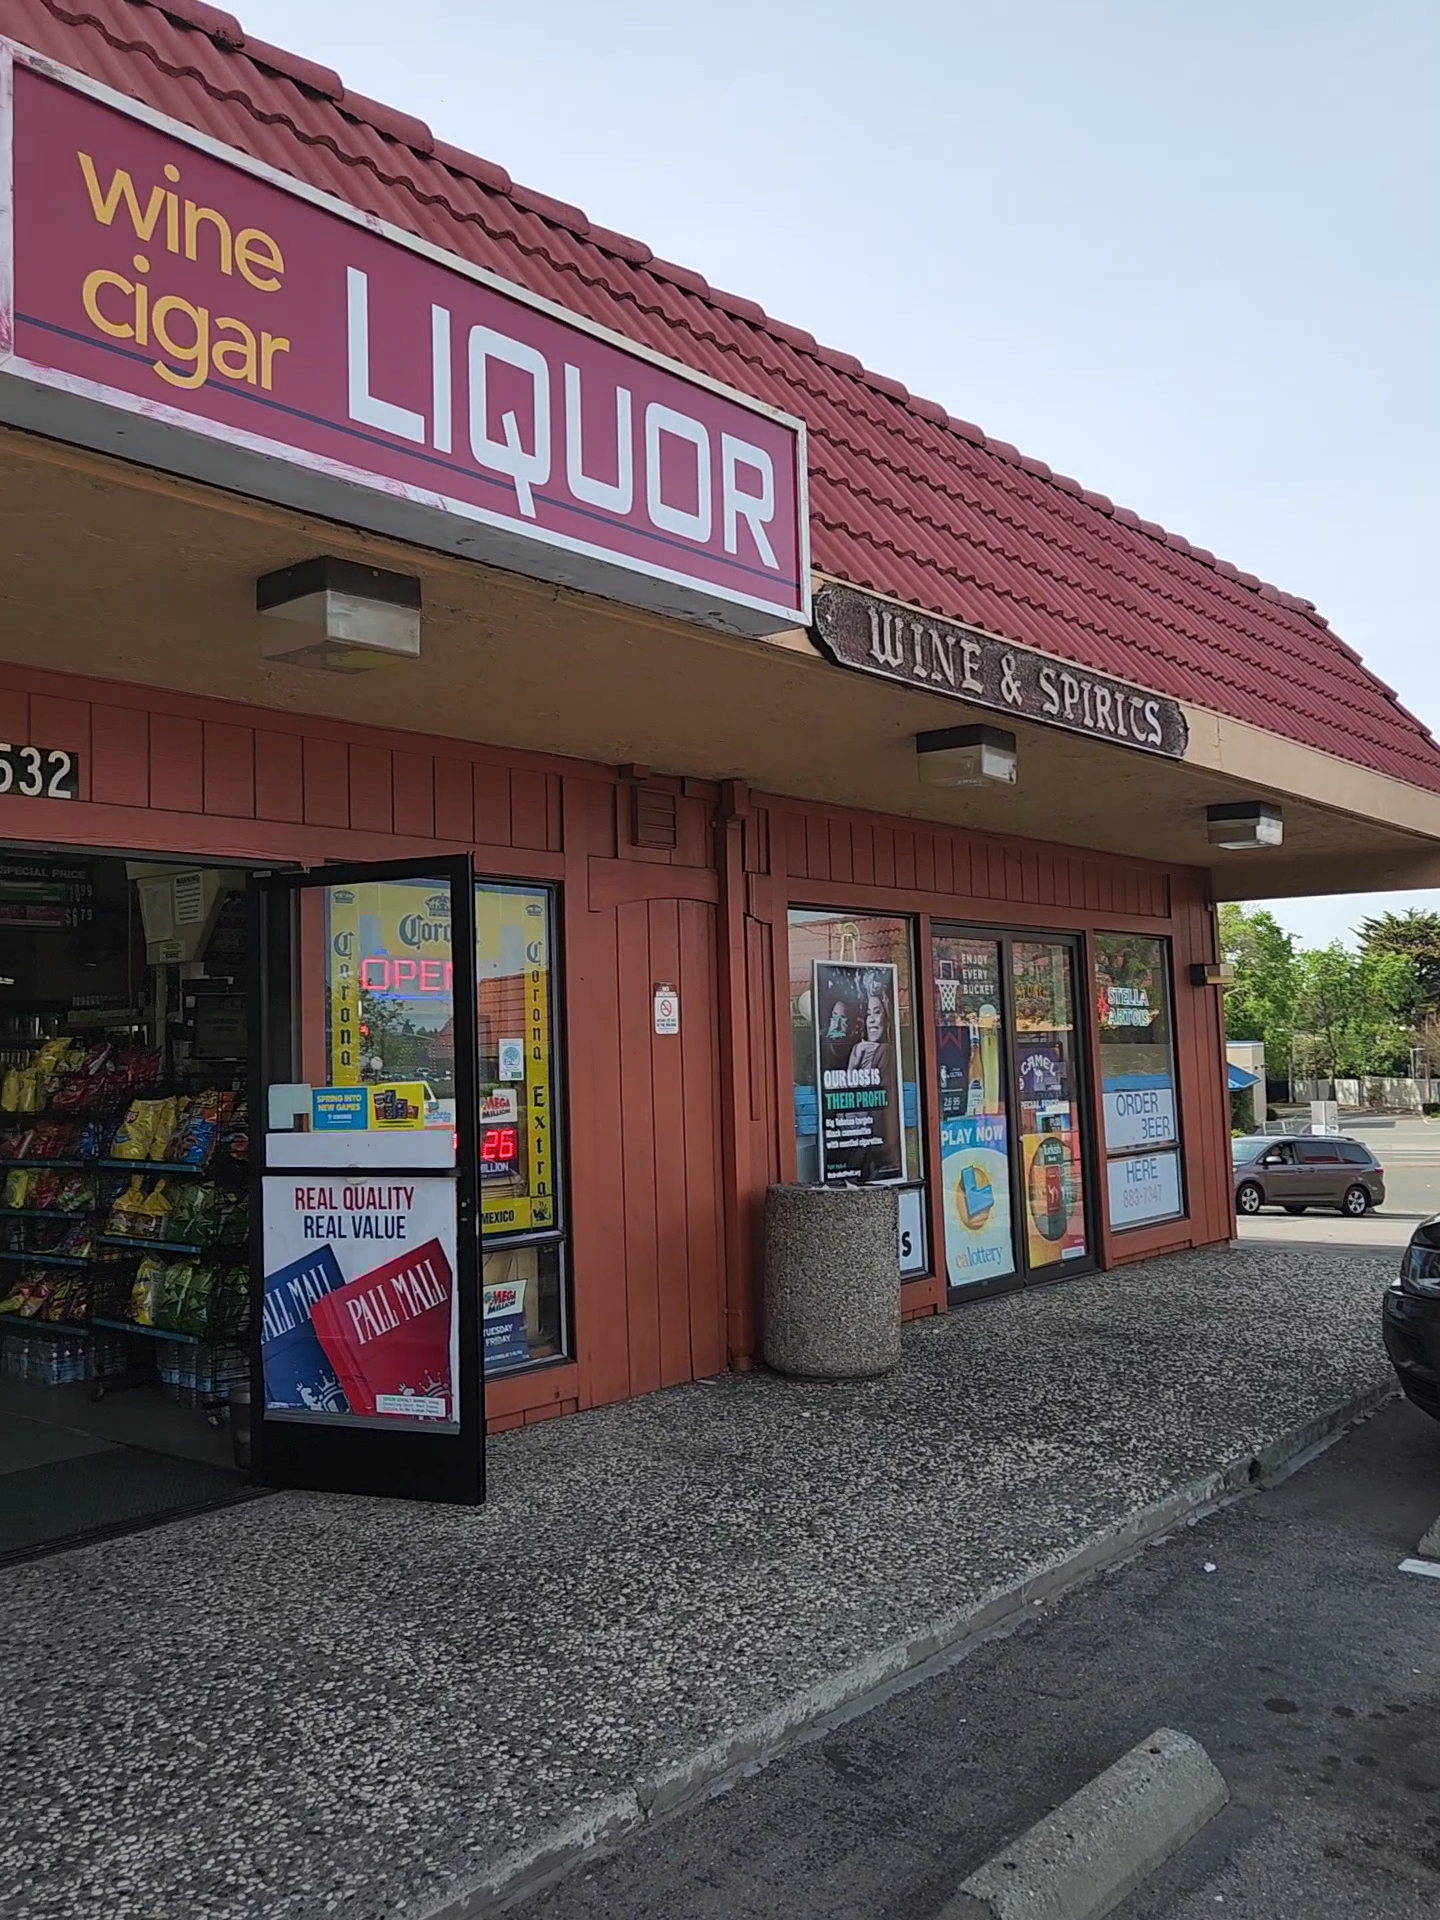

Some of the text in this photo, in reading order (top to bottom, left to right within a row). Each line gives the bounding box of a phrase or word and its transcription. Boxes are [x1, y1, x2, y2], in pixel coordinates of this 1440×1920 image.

[78, 151, 286, 293] wine
[82, 256, 291, 390] cigar
[347, 266, 780, 570] LIQUOR
[867, 606, 1163, 747] WINE & SPIRITS
[52, 868, 87, 880] PRICE
[961, 953, 988, 966] ENJOY
[962, 968, 989, 980] EVERY
[963, 984, 995, 996] BUCKET
[1107, 986, 1150, 1007] STELLA
[1108, 1007, 1151, 1028] ARTOIS
[525, 940, 547, 1197] Corona Extra
[1020, 1054, 1057, 1077] CAMEL
[824, 1068, 880, 1088] OUR LOSS IS
[316, 1093, 363, 1104] SPRING INTO
[317, 1103, 361, 1113] NEW GAMES
[825, 1090, 889, 1110] THEIR PROFIT.
[1115, 1091, 1159, 1117] ORDER
[941, 1125, 1004, 1146] PLAY NOW
[1126, 1158, 1159, 1184] HERE
[295, 1186, 415, 1212] REAL QUALITY
[304, 1215, 407, 1239] REAL VALUE
[481, 1209, 515, 1225] MEXICO
[956, 1246, 1003, 1269] calottery
[345, 1258, 449, 1346] PALL MALL
[260, 1288, 297, 1346] ALL
[483, 1323, 513, 1337] TUESDAY
[486, 1334, 511, 1347] FRIDAY
